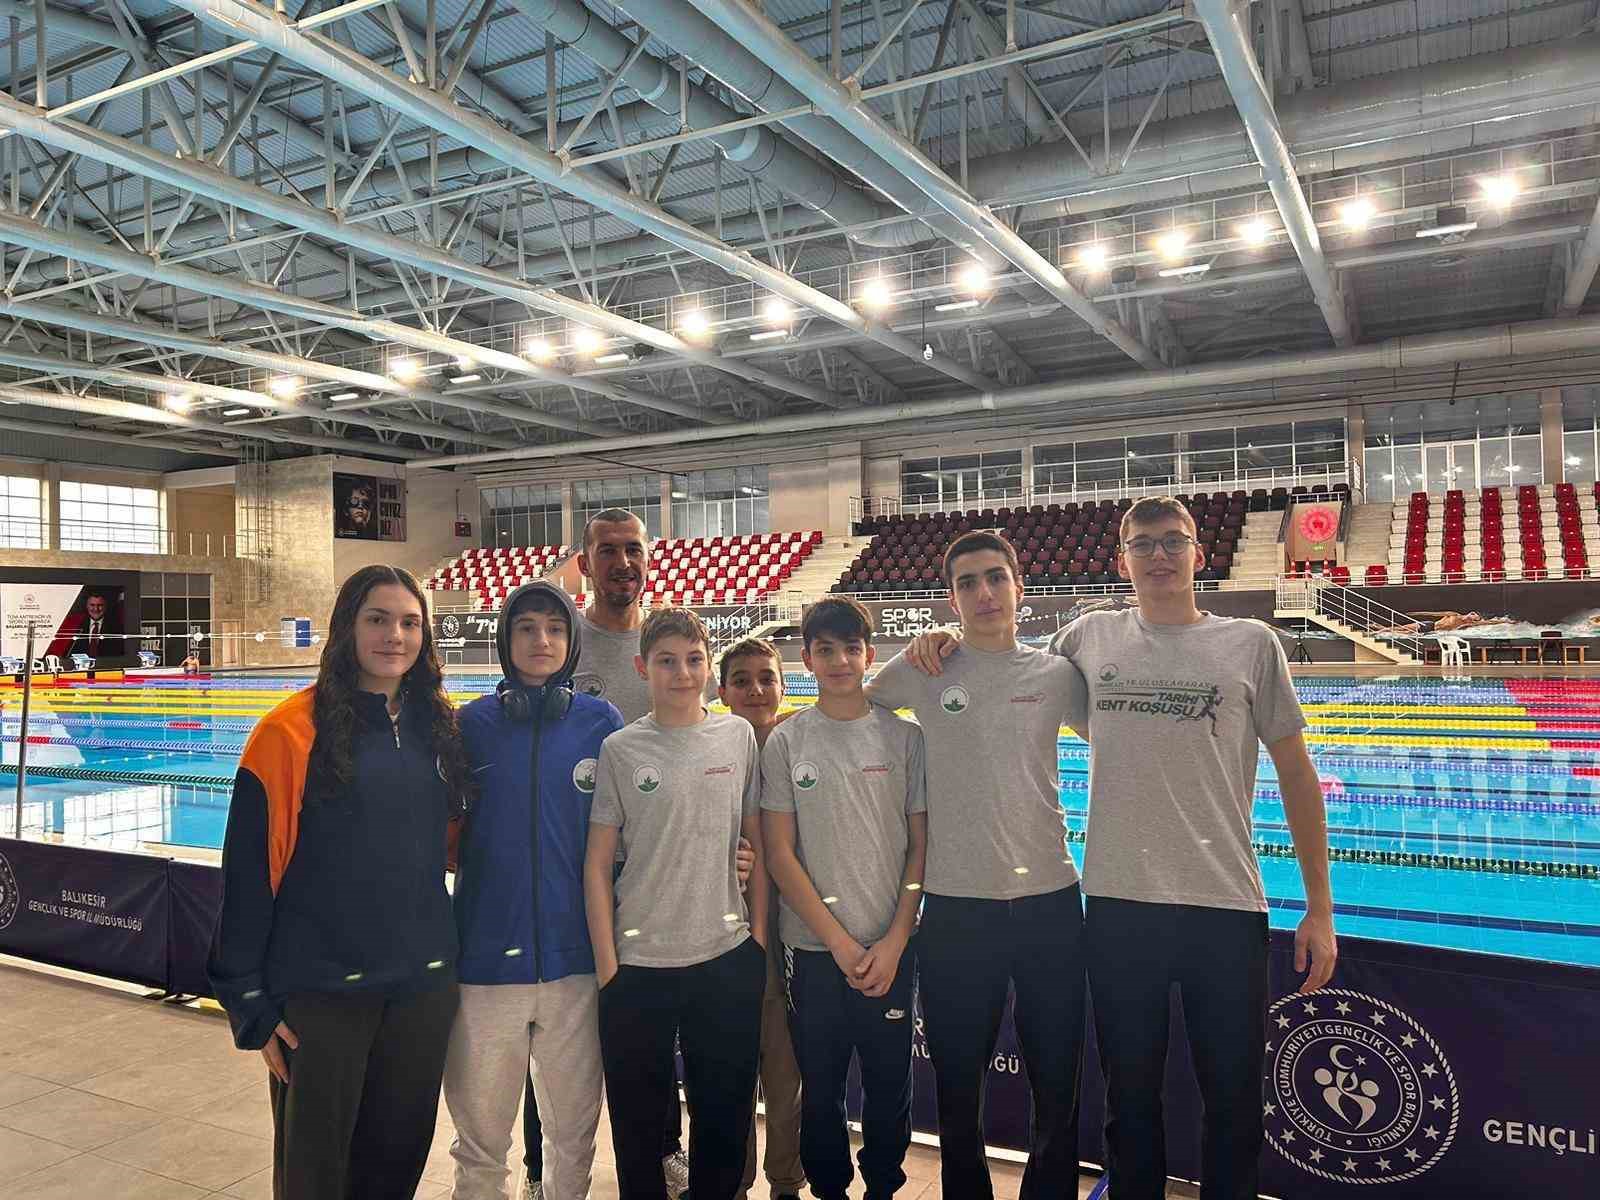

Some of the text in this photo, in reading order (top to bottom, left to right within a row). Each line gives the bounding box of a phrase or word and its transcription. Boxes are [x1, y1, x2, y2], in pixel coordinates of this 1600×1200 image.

[882, 607, 933, 623] SPOR
[1157, 692, 1200, 705] TARİHİ
[1096, 700, 1195, 716] KENT KOŞUSU
[62, 889, 106, 908] BALIKESİR
[58, 906, 69, 917] VE
[69, 908, 88, 921] SPOR
[1279, 1024, 1417, 1148] TÜRKİYE CUMHURİYETİ GENÇLİK VE SPOR BAKANLIĞI
[1482, 1119, 1595, 1155] GENÇLİ
